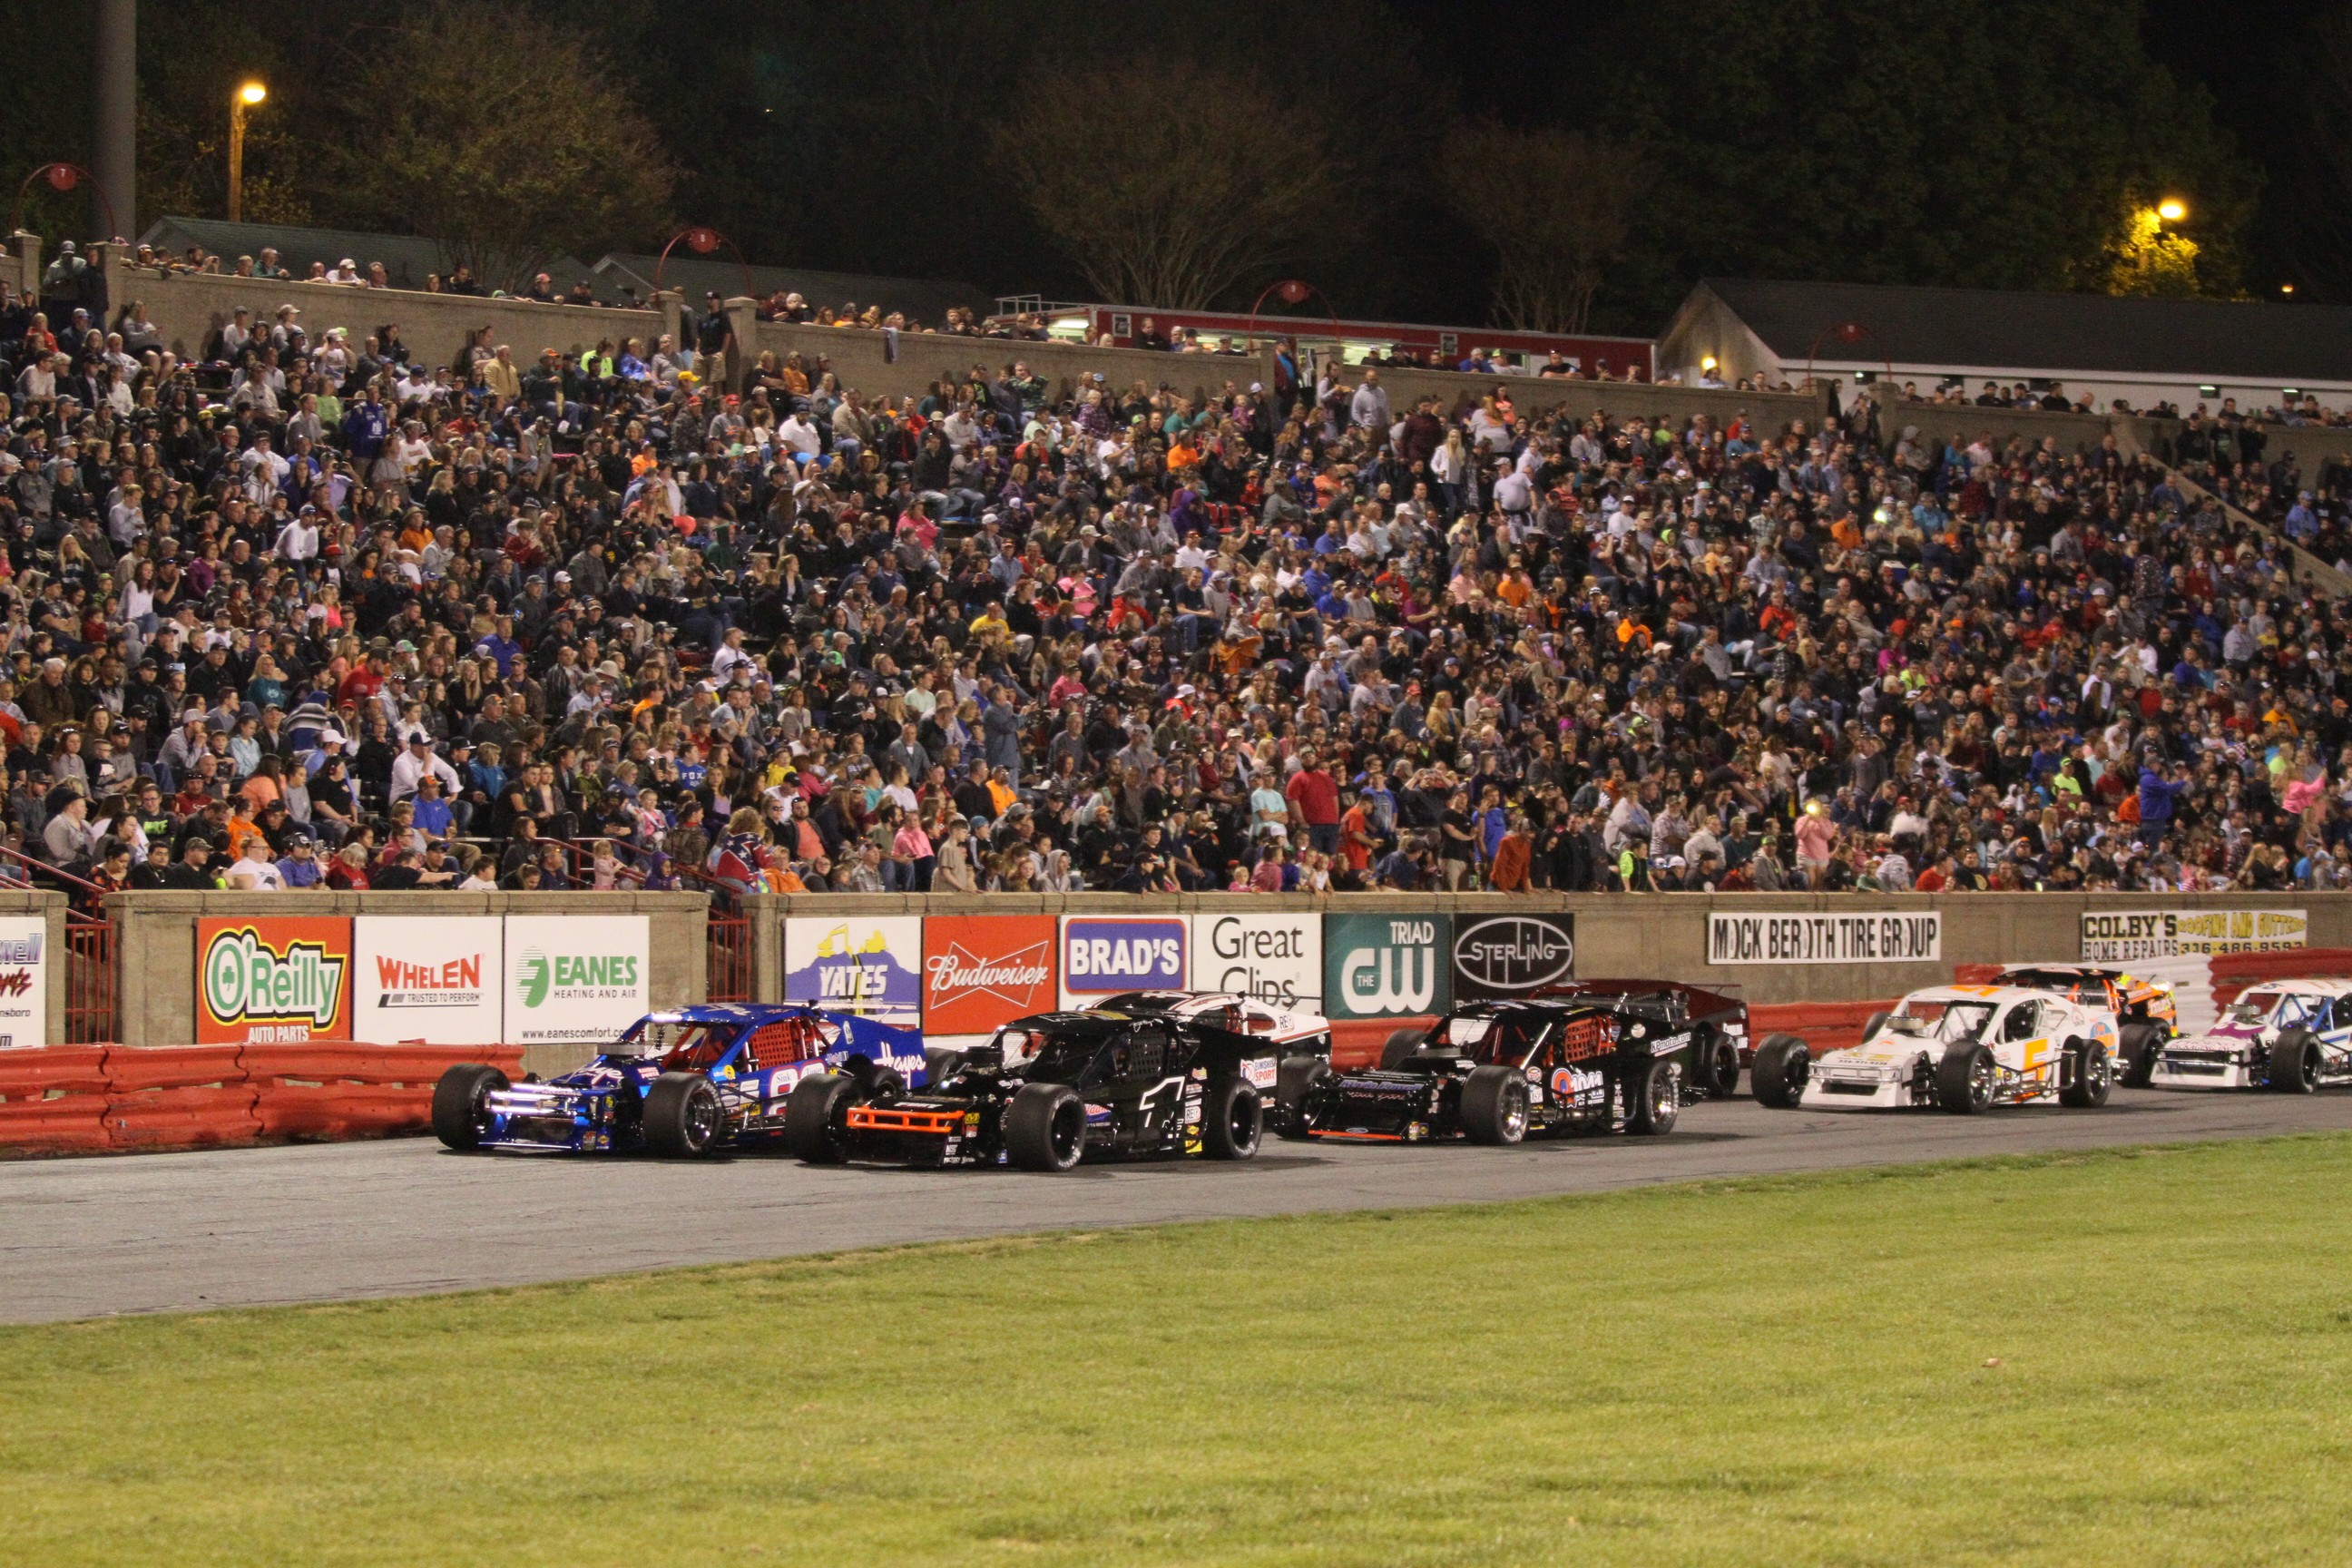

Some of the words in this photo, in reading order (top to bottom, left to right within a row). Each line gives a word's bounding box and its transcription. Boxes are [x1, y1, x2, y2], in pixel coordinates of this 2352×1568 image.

[1211, 916, 1304, 960] Great
[1390, 922, 1436, 945] TRIAD
[1839, 917, 1877, 958] TIRE
[2084, 914, 2177, 938] COLBY'S
[2178, 913, 2228, 937] ROOFING
[2230, 913, 2254, 938] AND
[1070, 938, 1180, 975] BRAD'S
[2083, 941, 2118, 960] HOME
[2123, 940, 2177, 959] REPAIRS
[209, 936, 338, 1019] O'Reilly
[376, 954, 480, 989] WHELEN
[555, 956, 638, 986] EANES
[819, 965, 888, 996] YATES
[926, 955, 1049, 992] Budweiser
[1357, 975, 1375, 987] THE
[407, 993, 437, 1003] TRUSTED
[439, 993, 448, 1003] TO
[449, 992, 479, 1003] PERFORM
[554, 990, 594, 999] HEATING
[598, 989, 618, 999] AND
[622, 989, 637, 999] AIR
[1220, 965, 1297, 1007] Clips
[248, 1026, 275, 1043] AUTO
[277, 1025, 309, 1043] PARTS
[522, 1027, 627, 1039] www.eanescomfort.co
[873, 1041, 926, 1089] Hayes
[1255, 1069, 1275, 1082] SPORT
